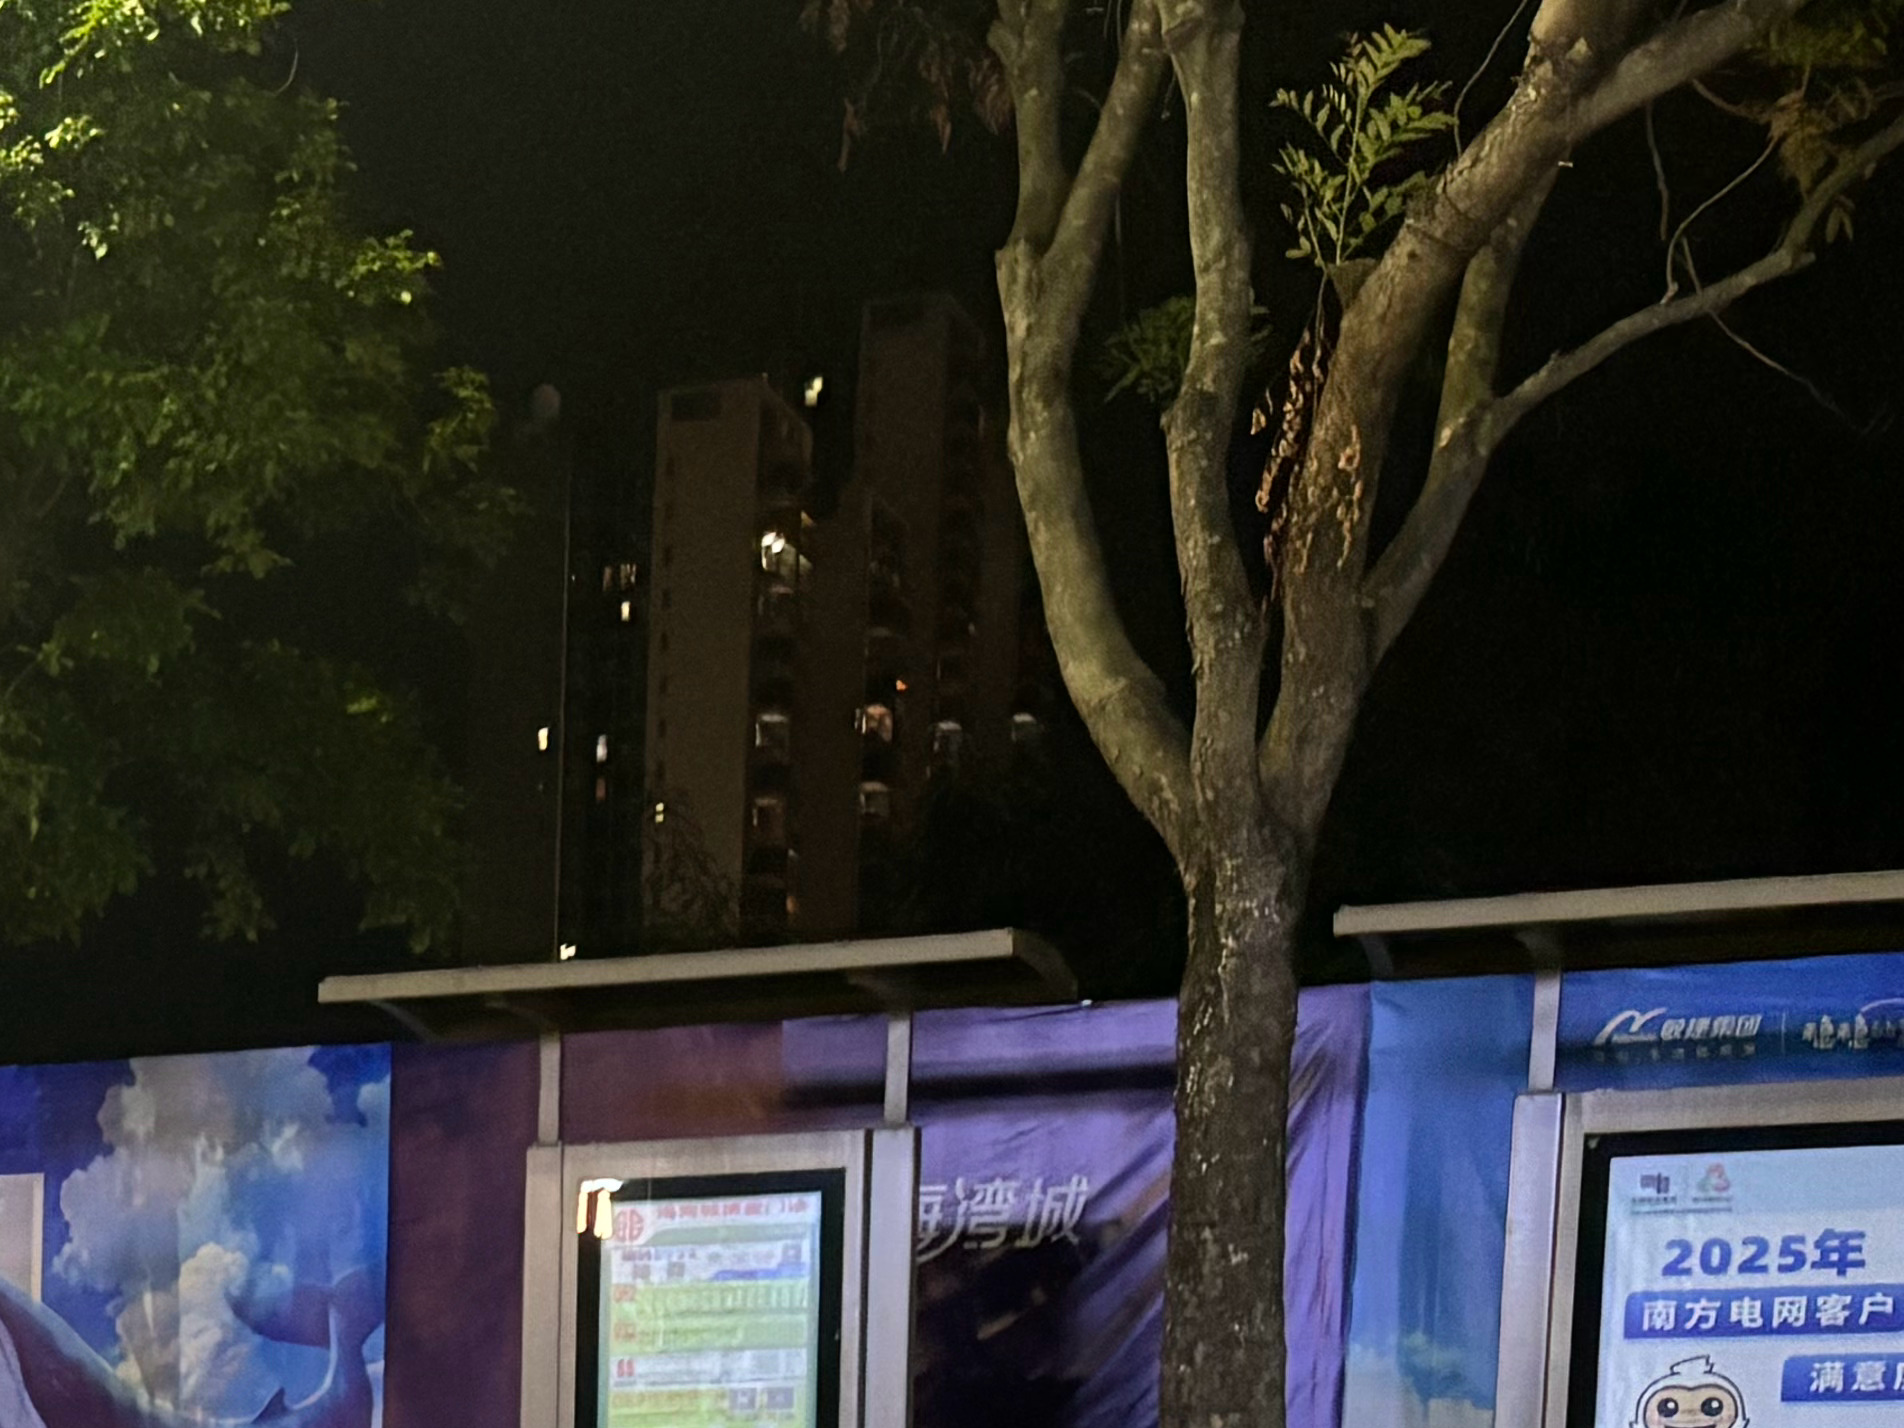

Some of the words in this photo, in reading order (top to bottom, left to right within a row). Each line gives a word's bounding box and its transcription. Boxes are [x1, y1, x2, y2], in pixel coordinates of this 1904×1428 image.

[1662, 1228, 1866, 1278] 2025年
[1643, 1292, 1894, 1331] 南方电网客户
